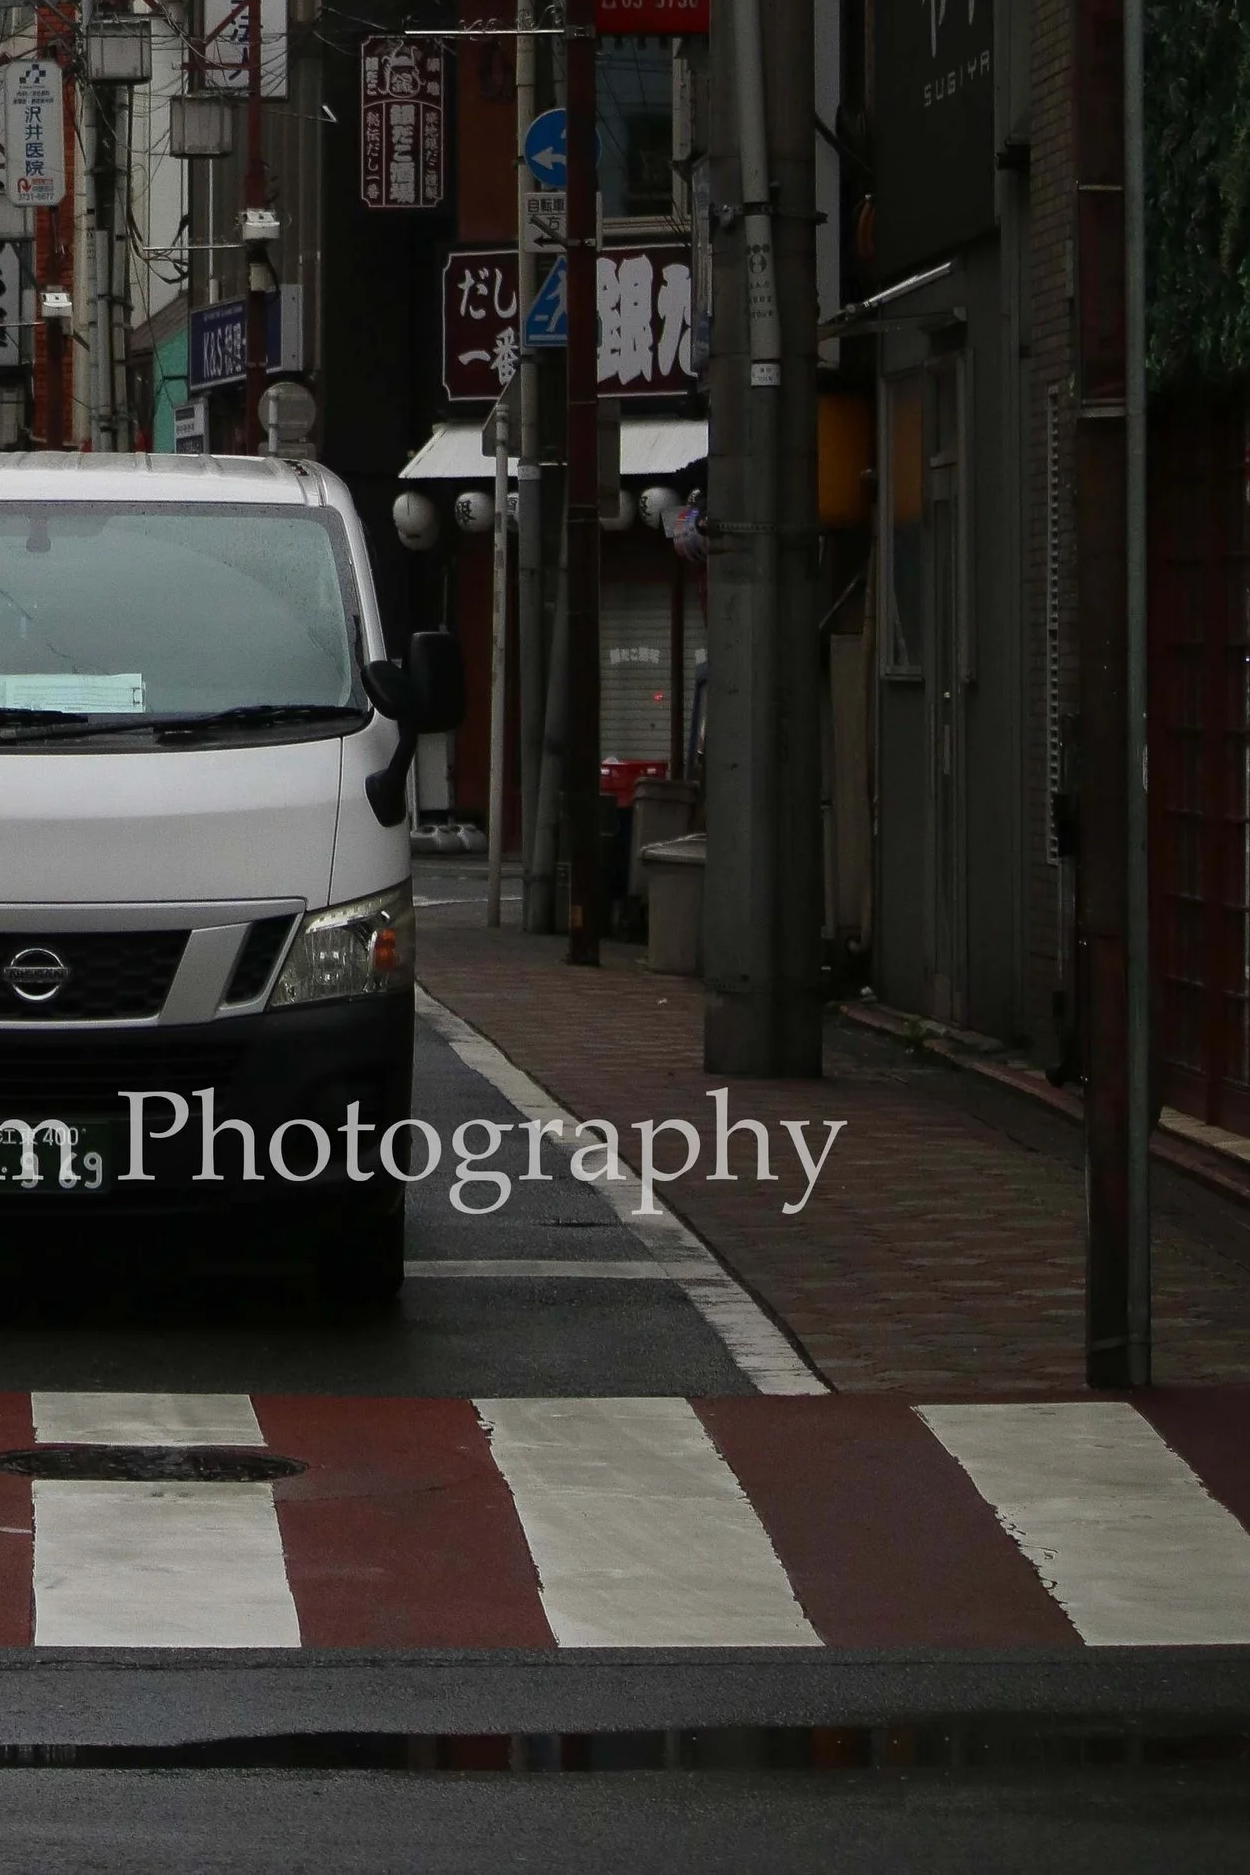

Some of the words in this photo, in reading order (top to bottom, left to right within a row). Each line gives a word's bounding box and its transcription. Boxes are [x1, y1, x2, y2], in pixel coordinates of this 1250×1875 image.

[922, 49, 991, 108] SUGIYA
[24, 106, 45, 177] 沢井医院
[527, 199, 565, 214] 自転車
[457, 267, 518, 319] だし
